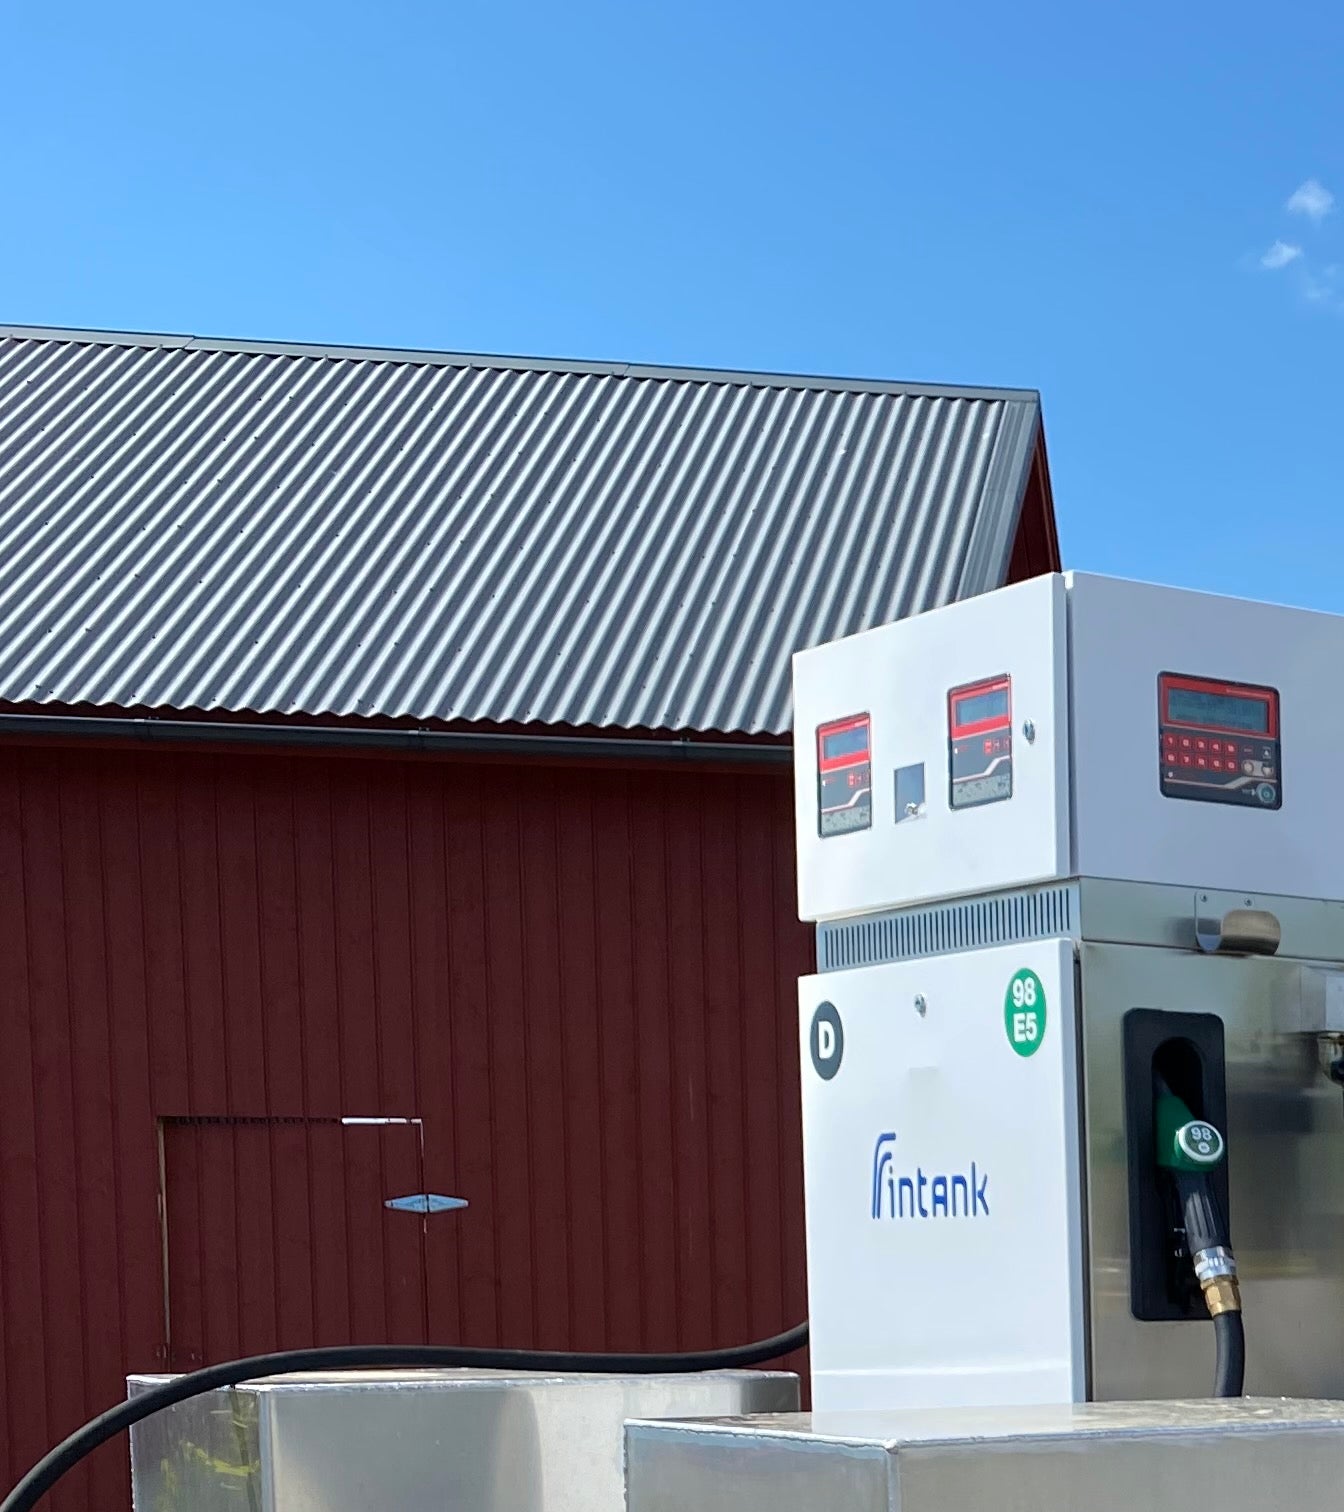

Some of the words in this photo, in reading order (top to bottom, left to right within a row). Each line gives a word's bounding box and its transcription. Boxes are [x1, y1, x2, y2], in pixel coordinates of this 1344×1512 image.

[1012, 977, 1036, 1007] 98
[818, 1021, 836, 1060] D
[1013, 1013, 1038, 1043] E5
[1191, 1127, 1212, 1141] 98
